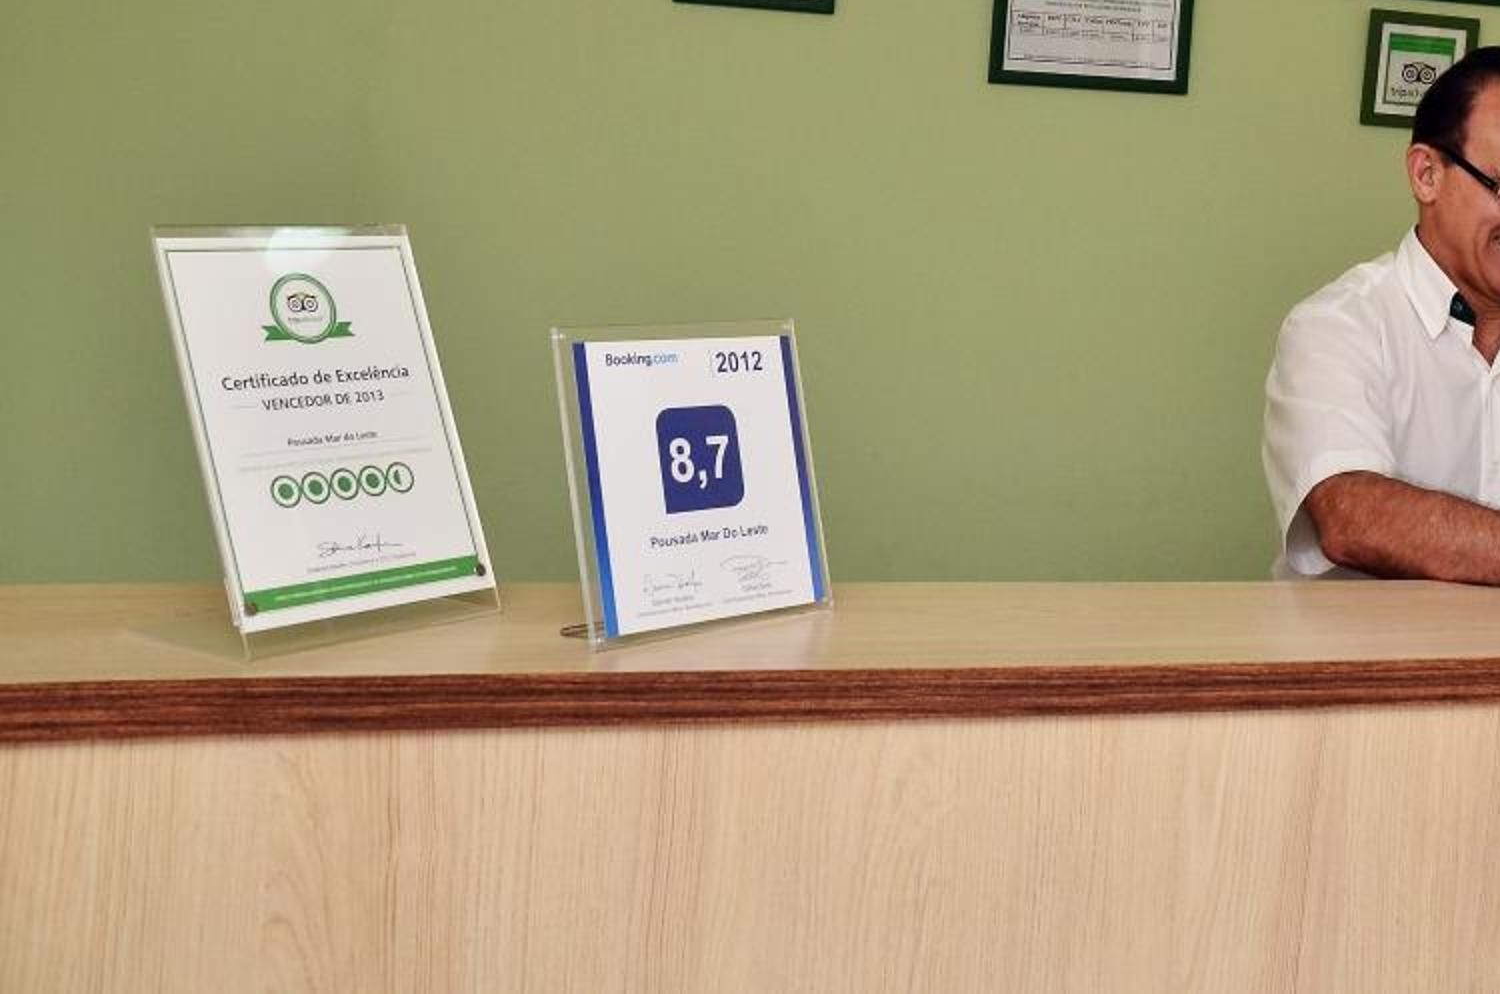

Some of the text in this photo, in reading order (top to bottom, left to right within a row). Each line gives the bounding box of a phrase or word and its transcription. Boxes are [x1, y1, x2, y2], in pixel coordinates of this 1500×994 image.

[605, 351, 763, 372] Booking.com 2012
[221, 365, 410, 391] Certificado de Excelência
[262, 389, 385, 411] VENCEDOR DE 2013
[287, 436, 323, 447] Pousada
[325, 434, 342, 443] Mar
[669, 435, 729, 489] 8,7
[651, 533, 699, 548] Pousada
[700, 529, 721, 542] Mar
[722, 527, 737, 539] Do
